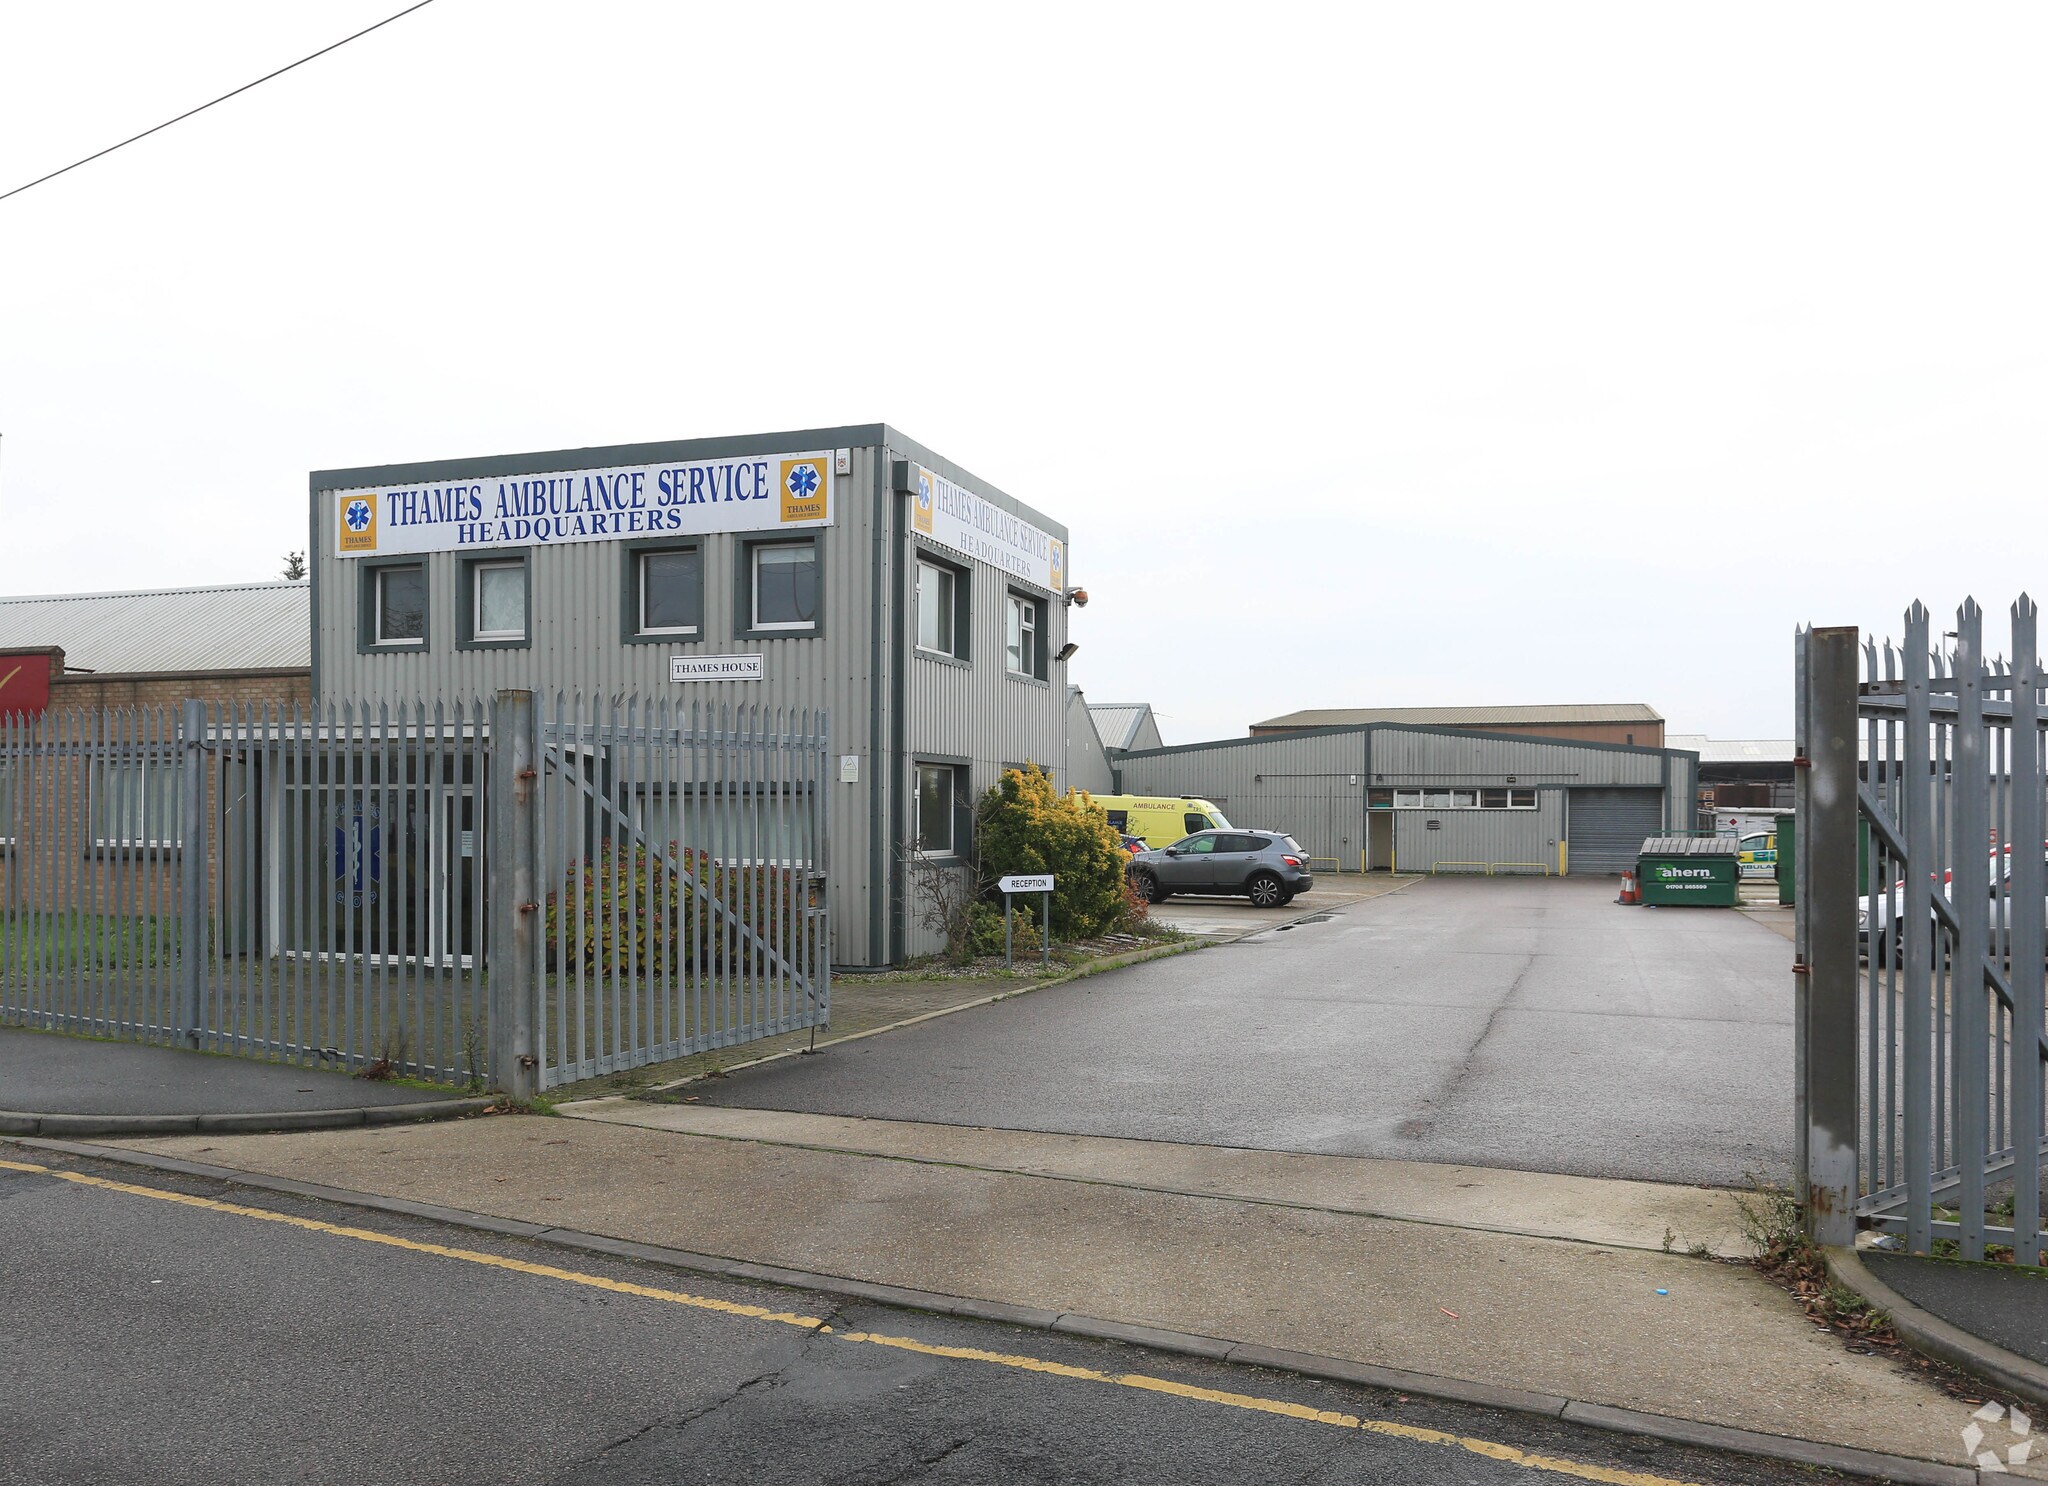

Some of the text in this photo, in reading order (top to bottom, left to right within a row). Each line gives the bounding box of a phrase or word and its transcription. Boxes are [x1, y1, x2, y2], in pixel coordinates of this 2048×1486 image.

[386, 462, 769, 526] THAMES AMBULANCE SERVICE
[787, 504, 821, 513] THAMES
[936, 479, 1048, 561] THAMES AMBULANCE SERVICE
[458, 508, 682, 543] HEADQUARTERS
[344, 536, 372, 544] THAMES
[960, 532, 1031, 578] HEADQUARTERS
[675, 662, 759, 673] THAMES HOUSE
[1133, 802, 1176, 810] AMBULANCE
[1661, 867, 1710, 877] ahern
[1011, 879, 1047, 888] RECEPTION
